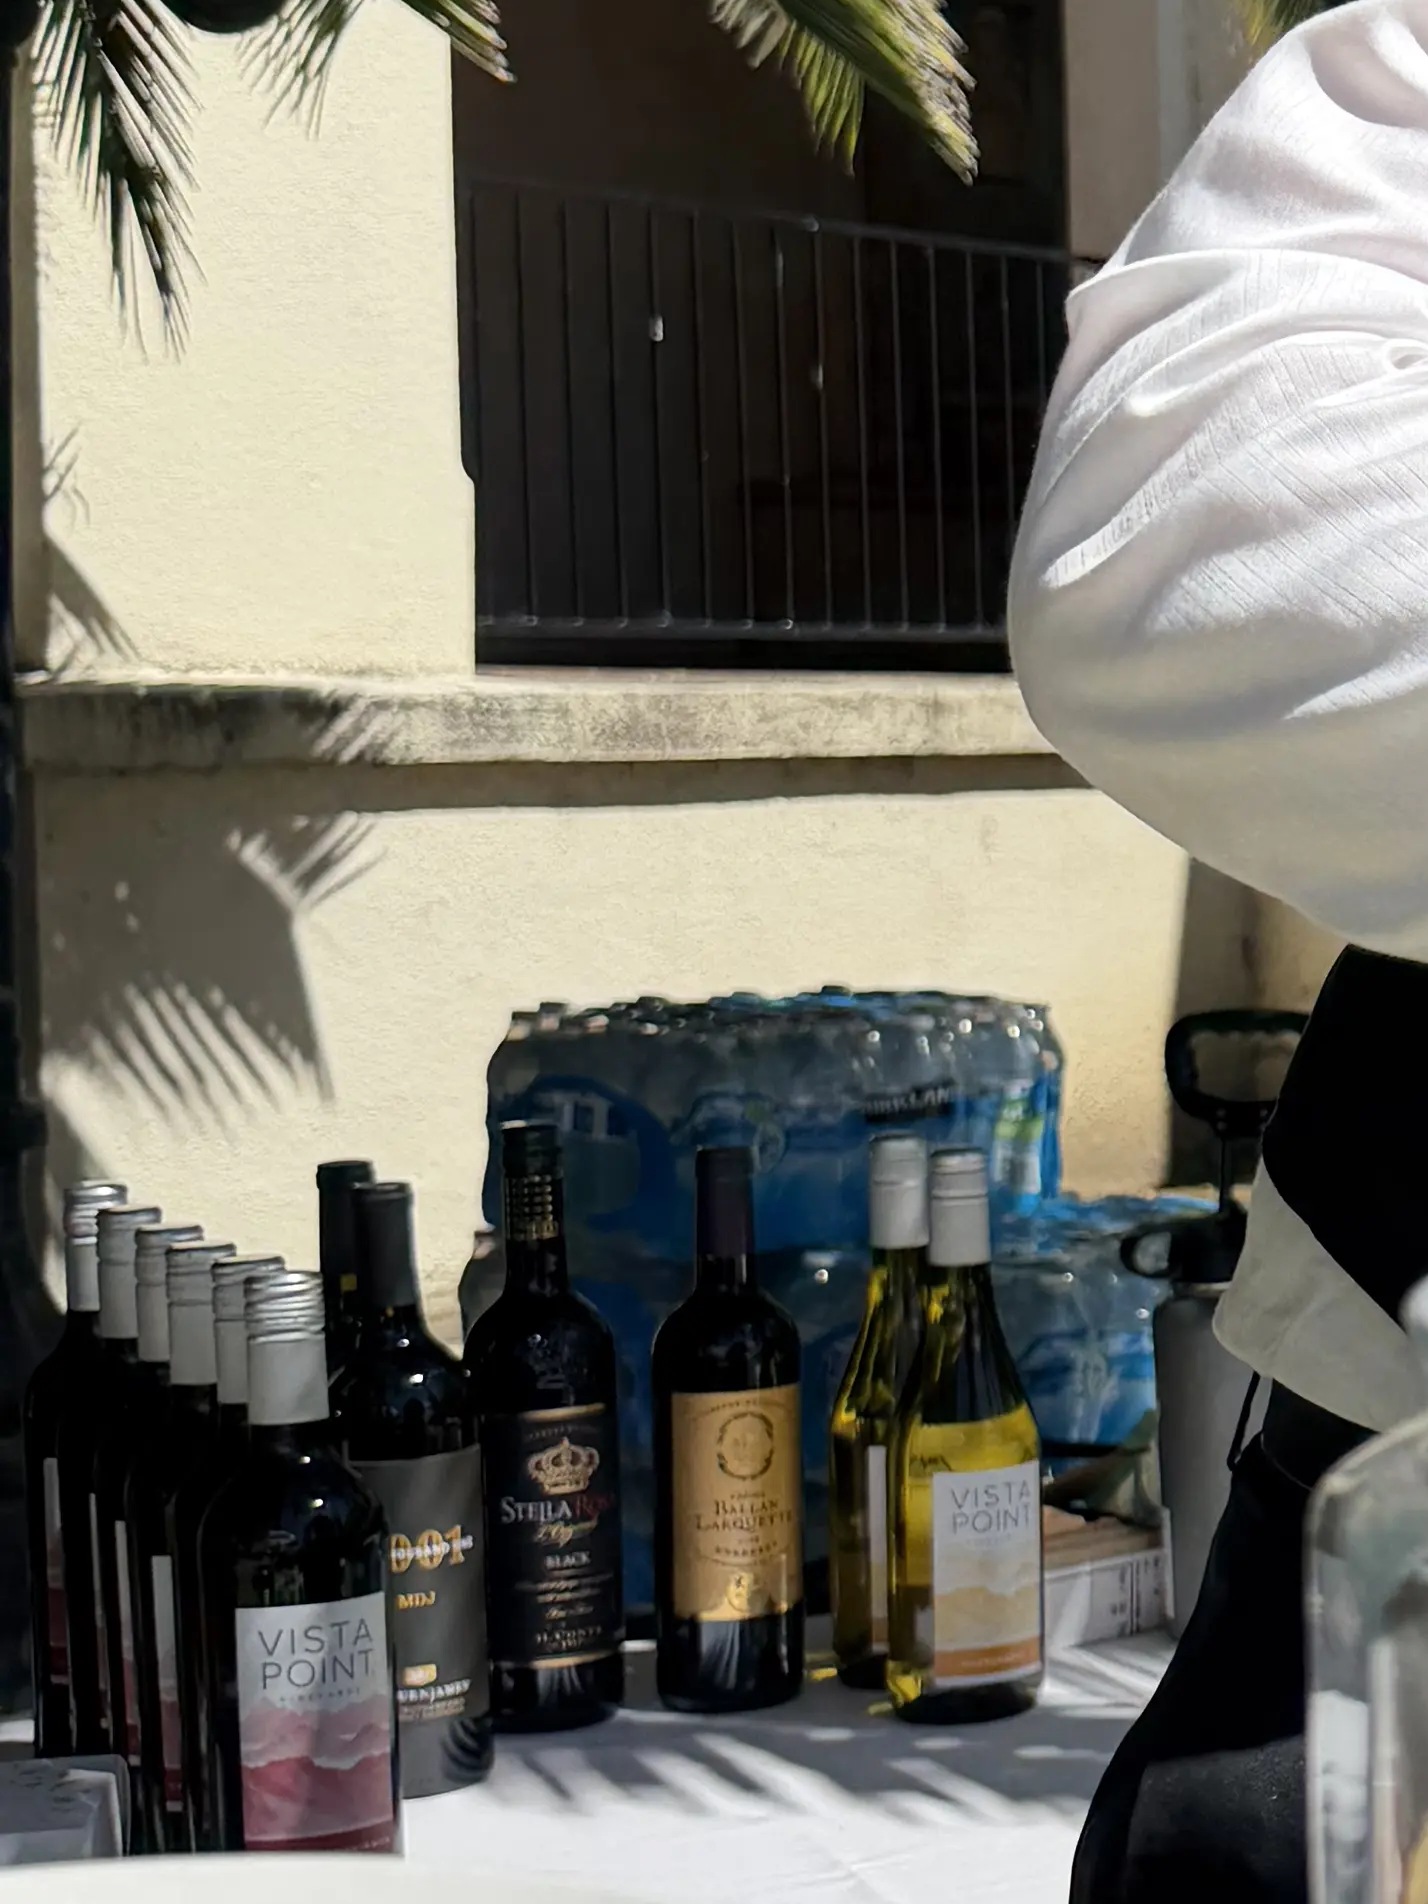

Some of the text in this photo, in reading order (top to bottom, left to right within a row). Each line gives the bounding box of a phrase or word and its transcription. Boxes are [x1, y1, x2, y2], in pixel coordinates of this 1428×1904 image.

[951, 1479, 1031, 1509] VISTA
[501, 1495, 573, 1524] STELLA
[952, 1503, 1031, 1534] POINT
[545, 1551, 591, 1569] BLACK
[258, 1617, 373, 1656] VISTA
[261, 1648, 374, 1690] POINT
